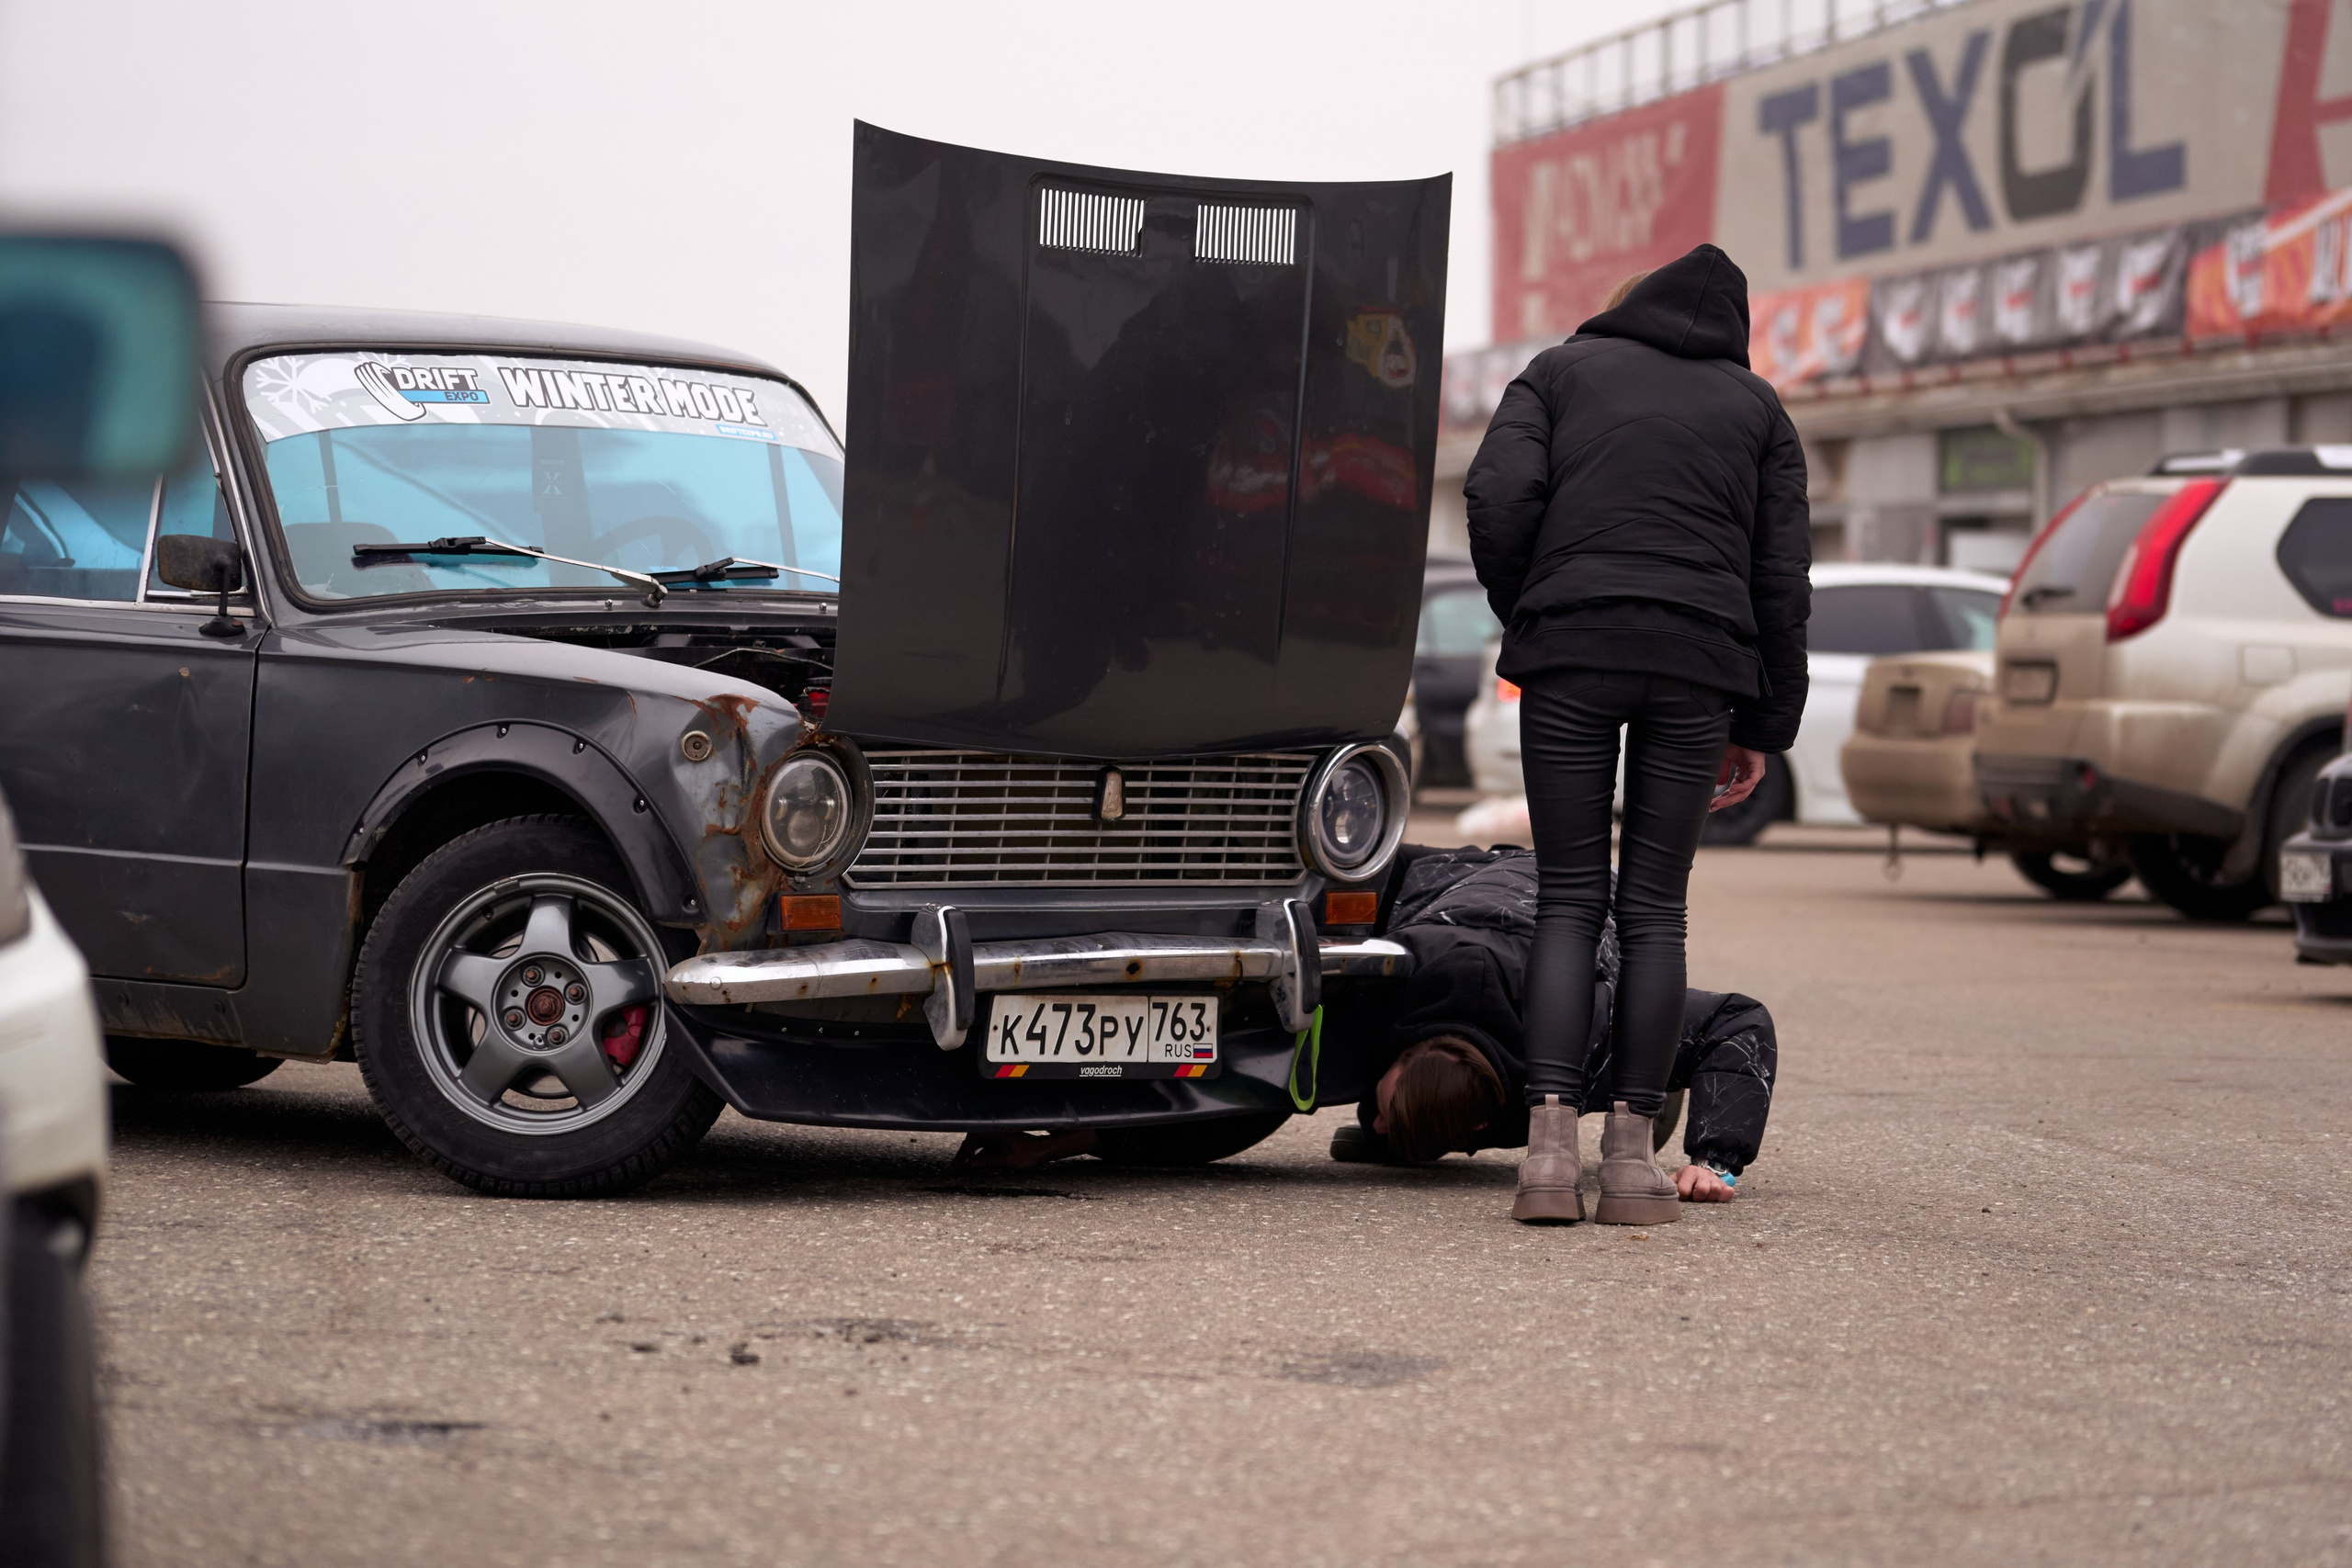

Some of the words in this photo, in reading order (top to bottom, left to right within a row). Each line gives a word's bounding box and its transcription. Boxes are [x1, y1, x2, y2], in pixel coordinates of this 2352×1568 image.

[1759, 0, 2187, 272] TEXOL
[392, 367, 478, 390] DRIFT
[445, 391, 479, 401] EXPO
[497, 367, 666, 415] WINTER
[659, 378, 768, 426] MODE
[1151, 1002, 1207, 1042] 763
[1165, 1043, 1193, 1057] RUS
[1080, 1065, 1123, 1077] vagodroch
